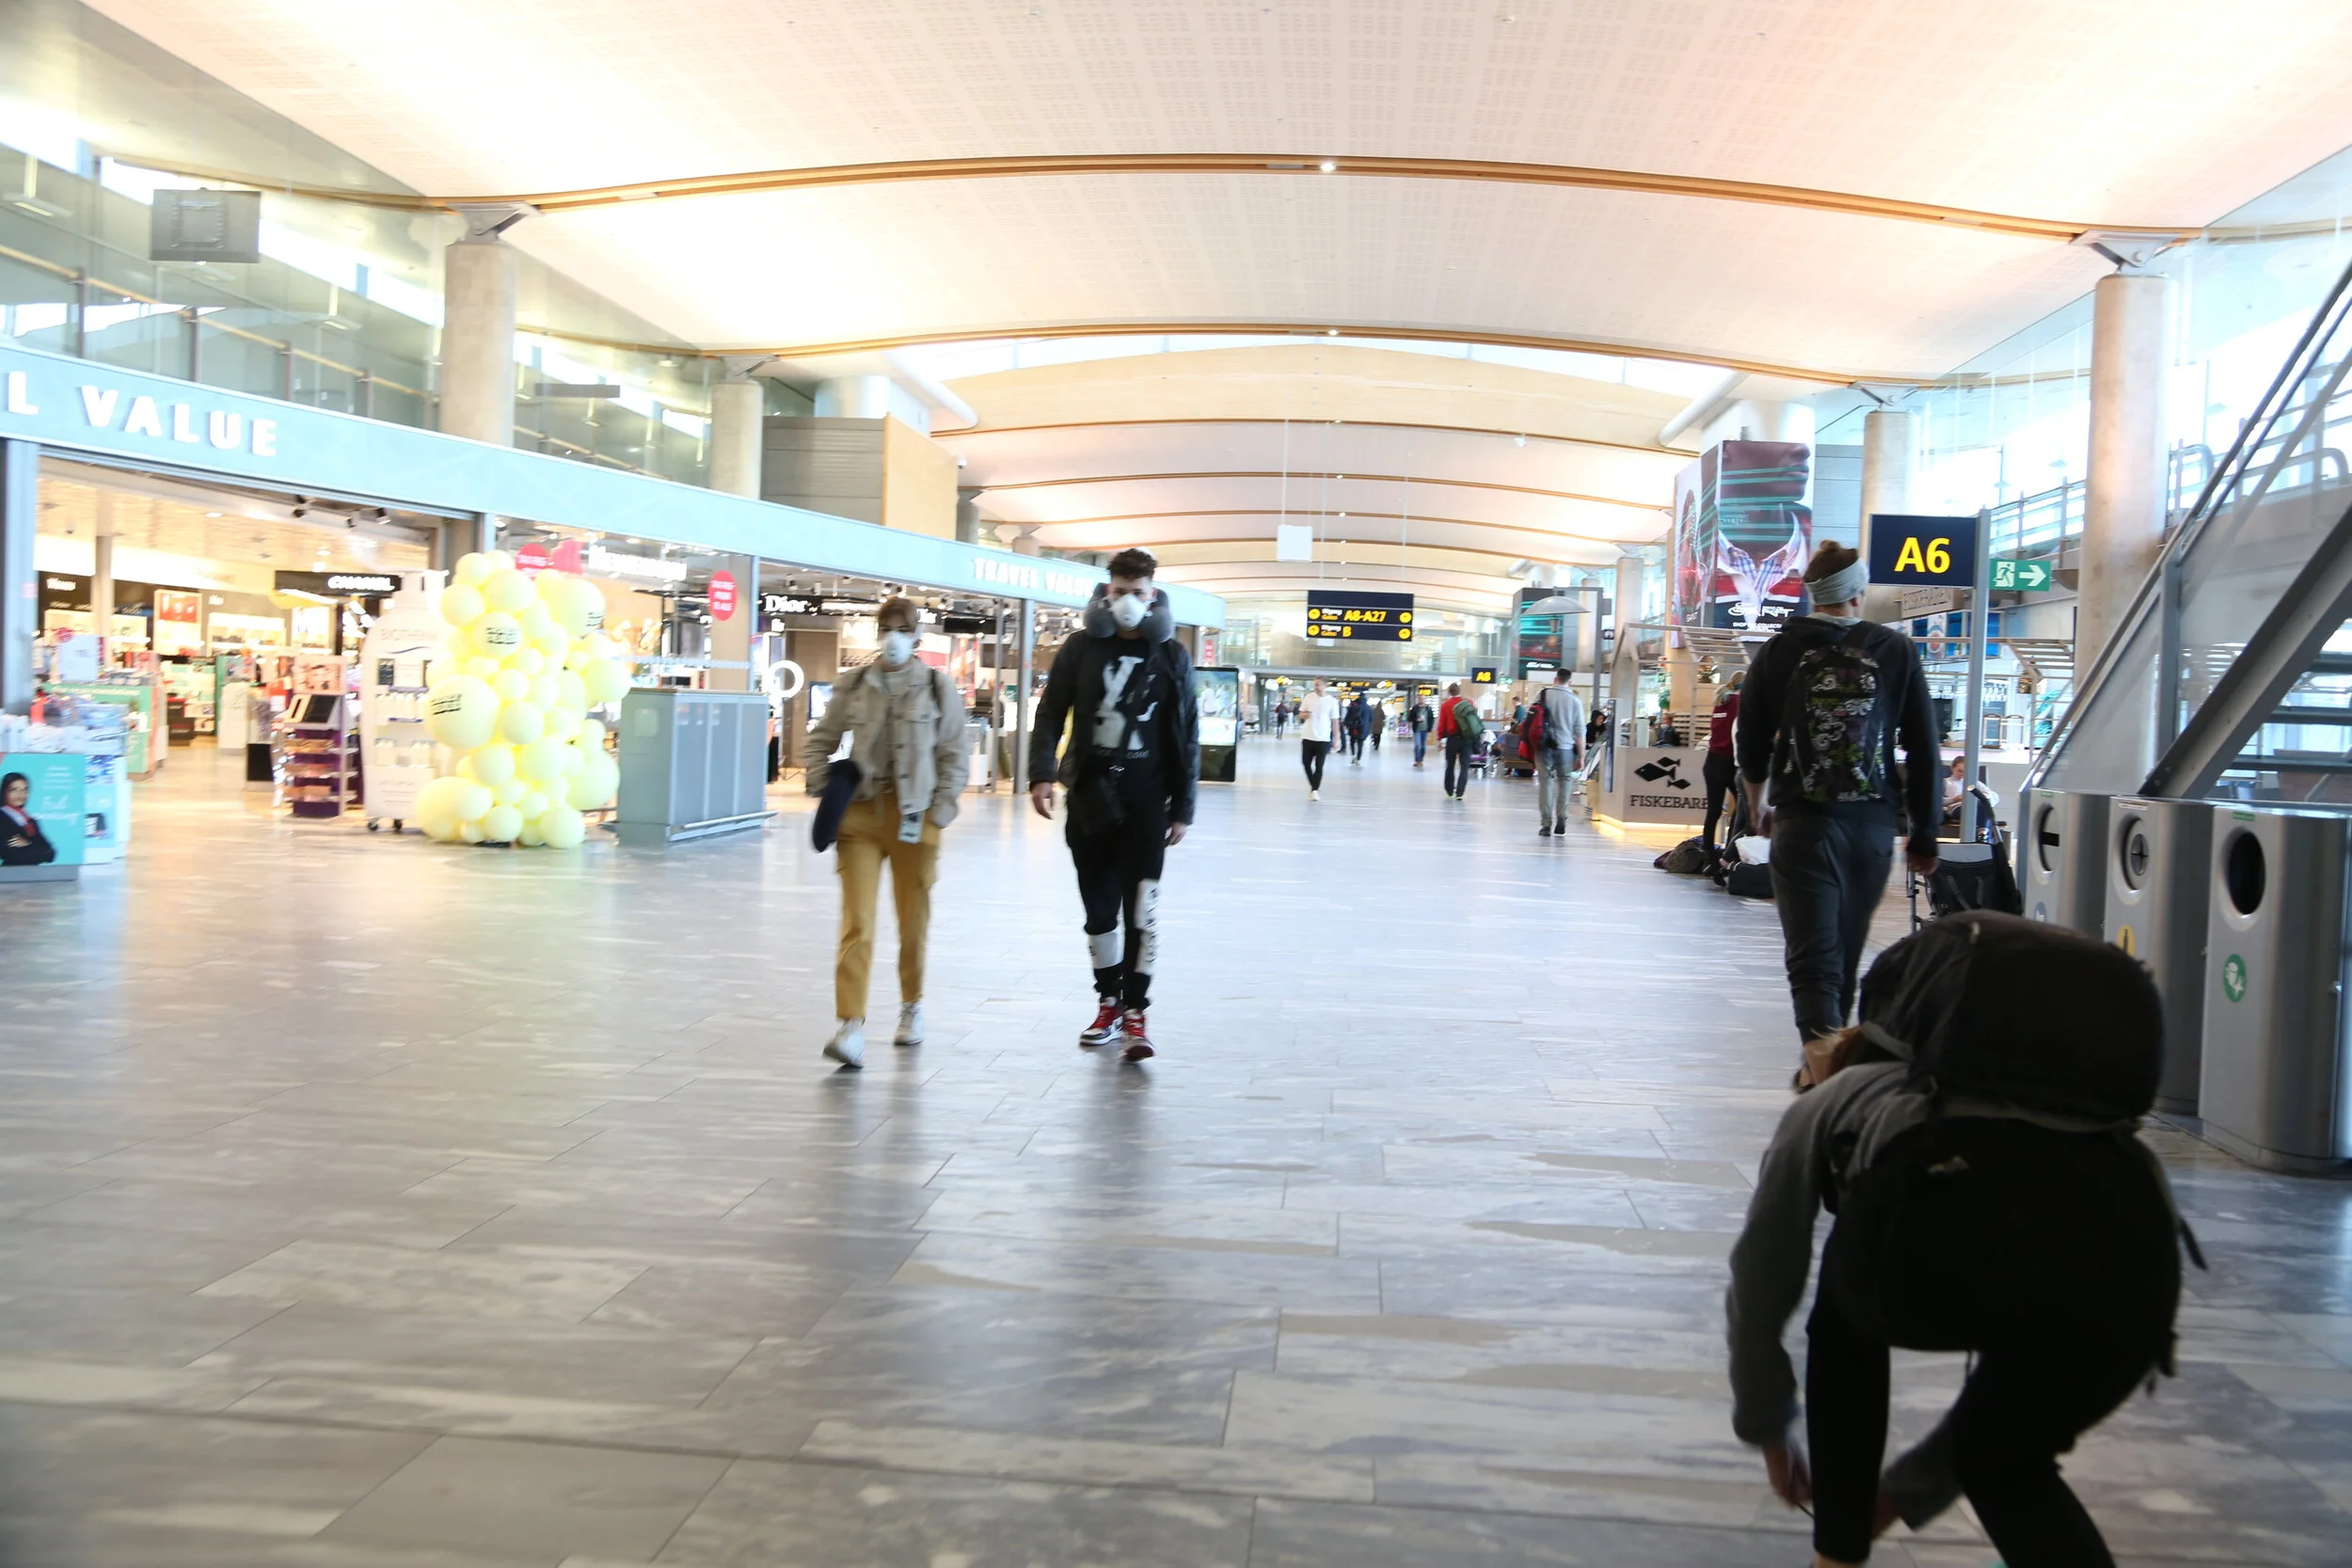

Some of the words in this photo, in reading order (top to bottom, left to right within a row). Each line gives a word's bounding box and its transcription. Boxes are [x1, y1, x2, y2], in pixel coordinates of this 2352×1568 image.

[80, 384, 277, 457] VALUE
[1894, 536, 1951, 574] A6
[327, 575, 395, 592] CHANEL
[973, 557, 1040, 589] TRAVEL
[763, 594, 809, 613] Dior
[1342, 626, 1352, 637] B
